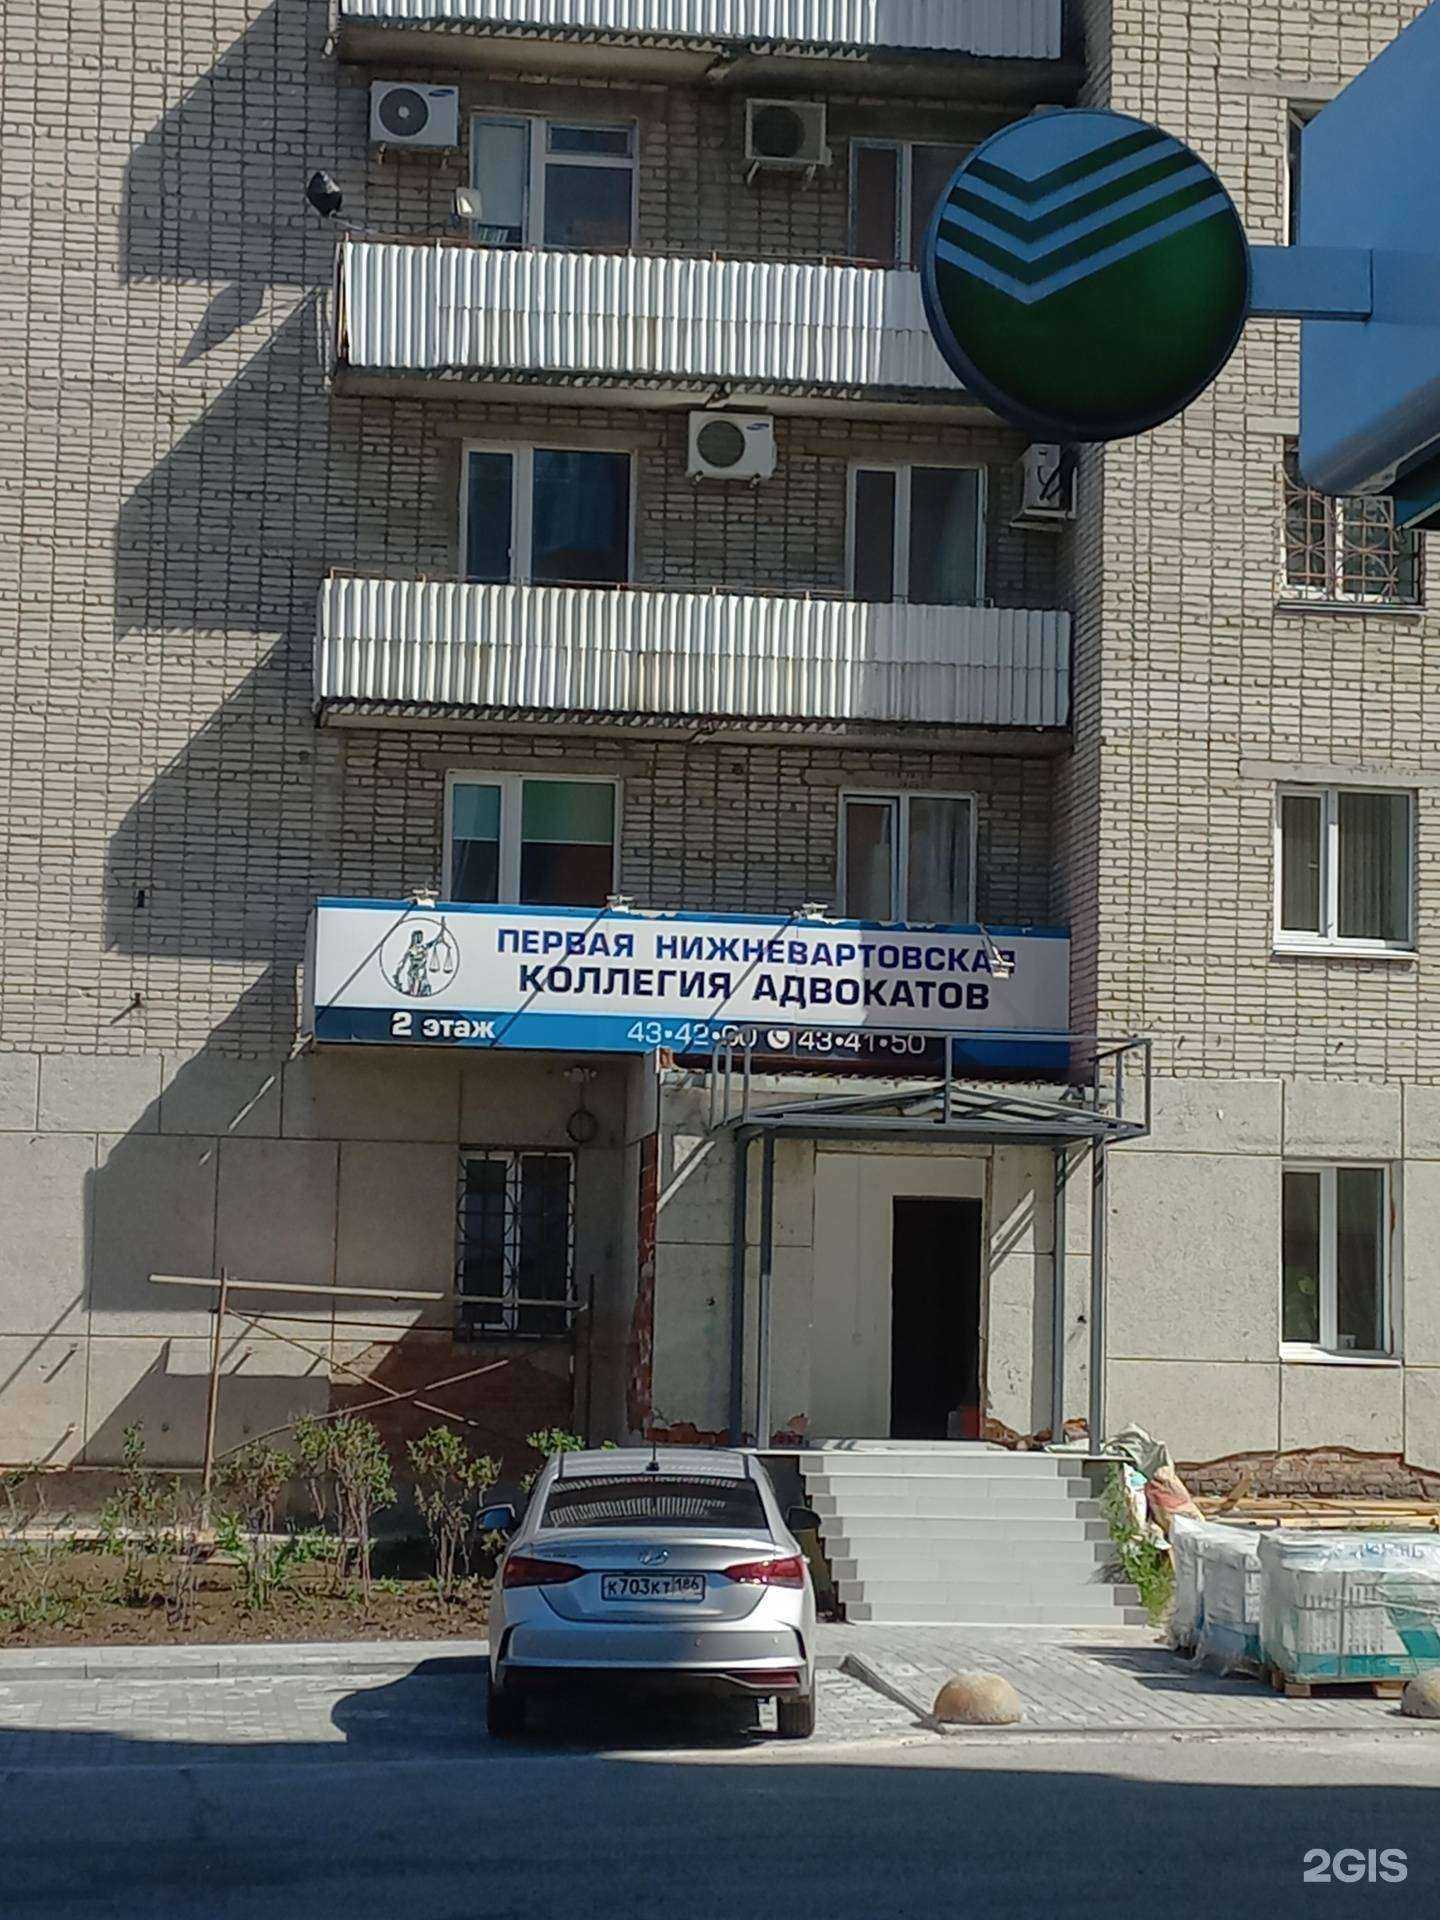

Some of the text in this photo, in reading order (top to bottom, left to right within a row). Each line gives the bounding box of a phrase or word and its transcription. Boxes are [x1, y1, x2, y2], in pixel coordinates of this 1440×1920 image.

[497, 928, 634, 959] ПЕРВАЯ
[518, 964, 990, 1010] КОЛЛЕГИЯ АДВОКАТОВ
[391, 1011, 496, 1040] 2 этаж
